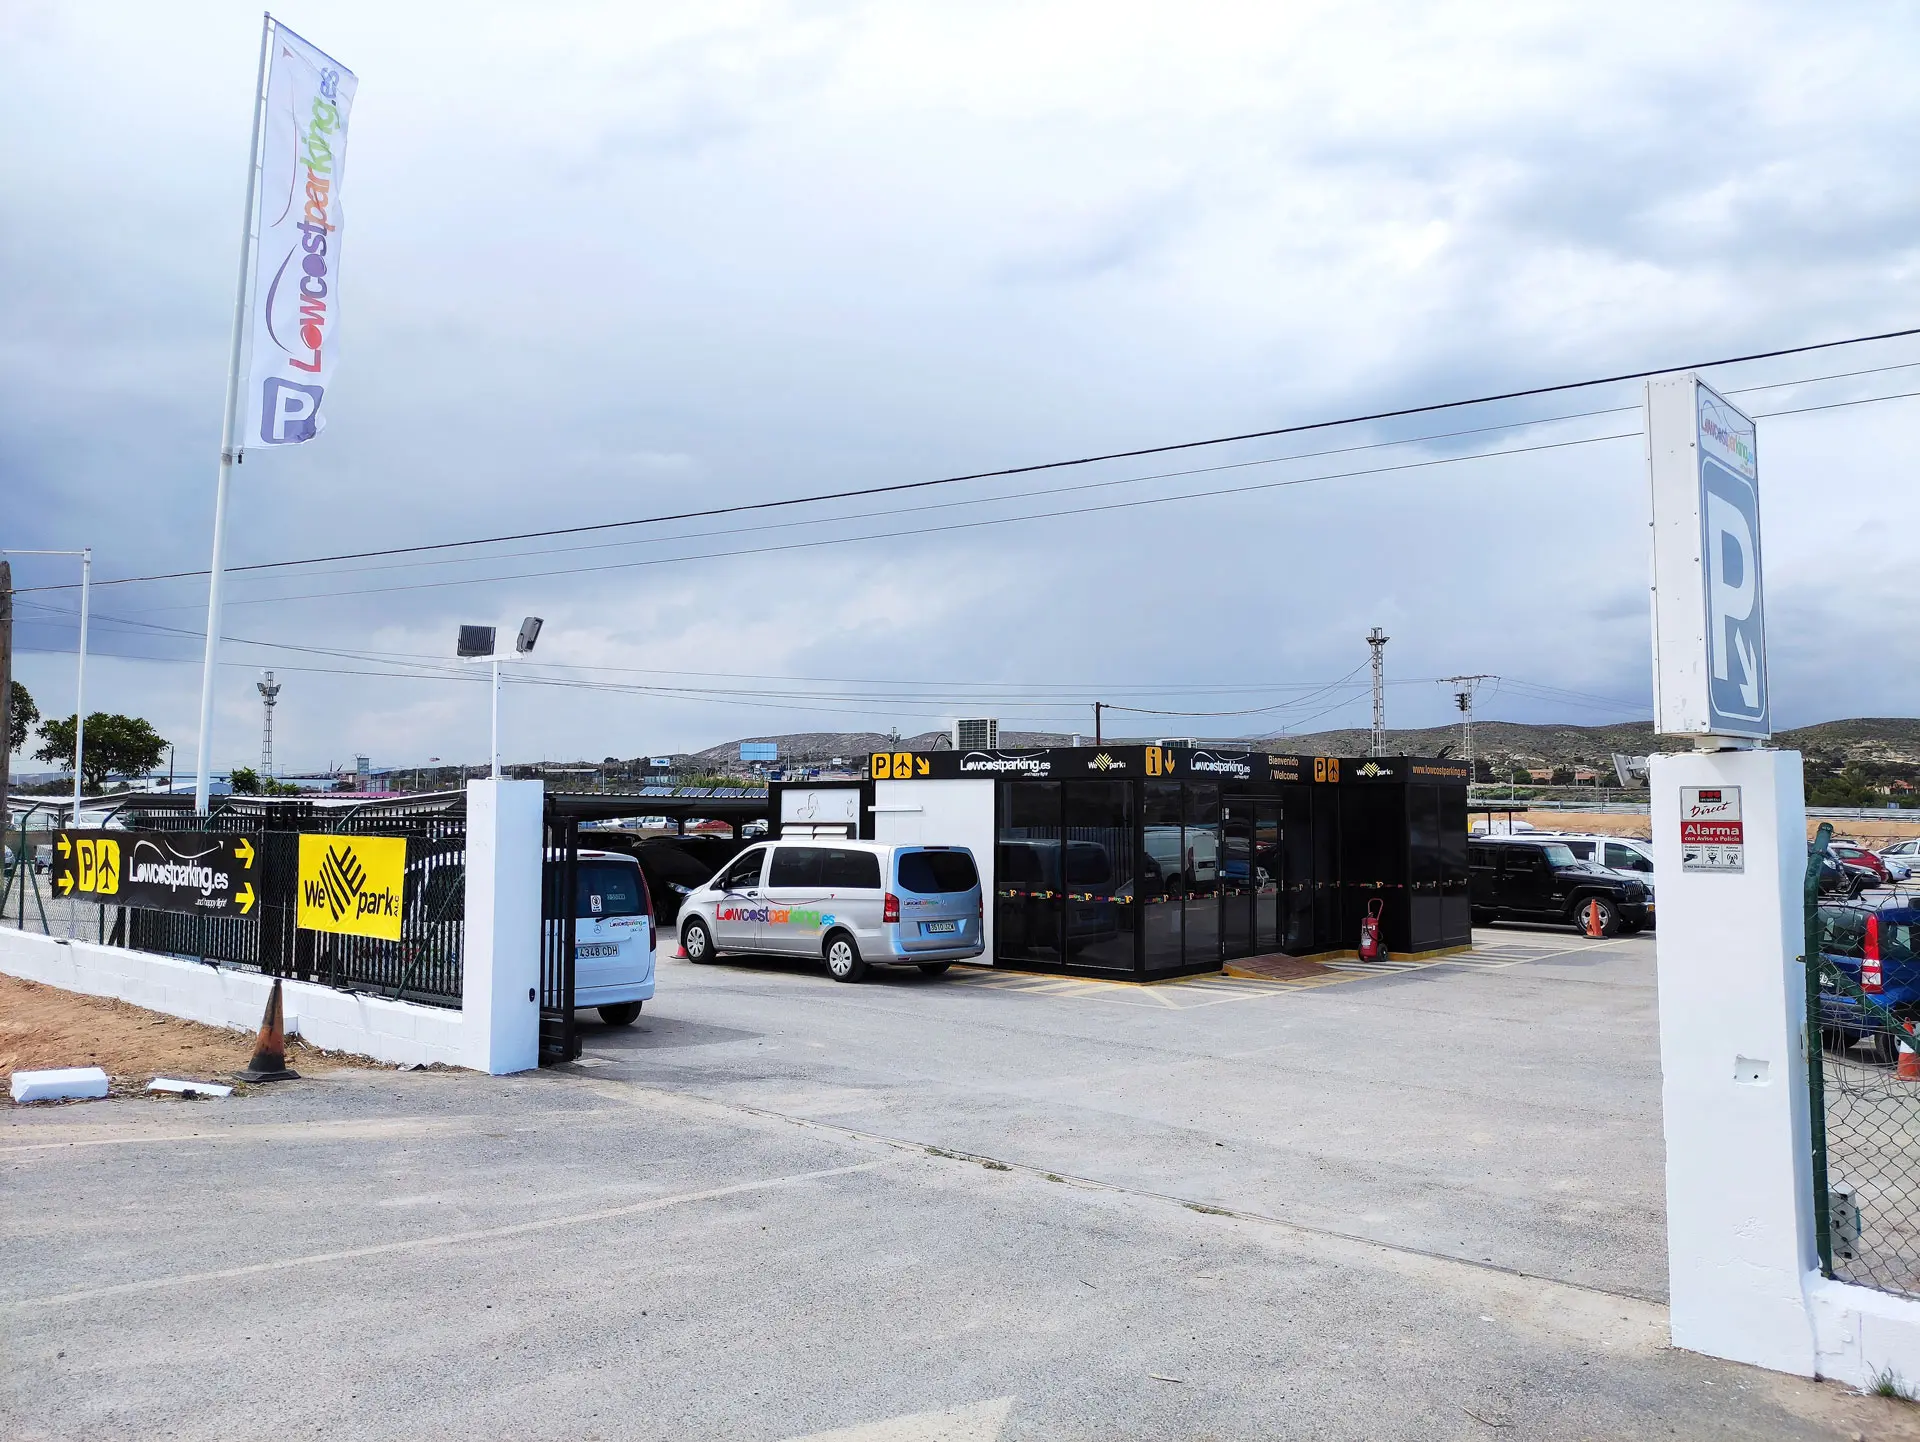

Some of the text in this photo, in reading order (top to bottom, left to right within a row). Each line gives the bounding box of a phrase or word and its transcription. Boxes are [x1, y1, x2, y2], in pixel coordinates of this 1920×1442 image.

[289, 67, 340, 372] Lowcostparking.es
[273, 385, 315, 440] P
[1707, 490, 1756, 681] P
[875, 757, 886, 776] P
[960, 758, 1051, 773] Lowcostparking.es
[1088, 761, 1098, 769] We
[1109, 760, 1124, 770] park
[1190, 758, 1251, 775] Lowcostparking.es
[1268, 755, 1299, 766] Bienvenido
[1274, 770, 1299, 780] Welcome
[1685, 823, 1740, 836] Alarma
[82, 846, 93, 884] P
[129, 856, 228, 896] Lowcostparking.es
[304, 880, 394, 920] We park
[716, 904, 836, 929] Lowcostparking.es
[580, 945, 618, 957] 4348 CDH
